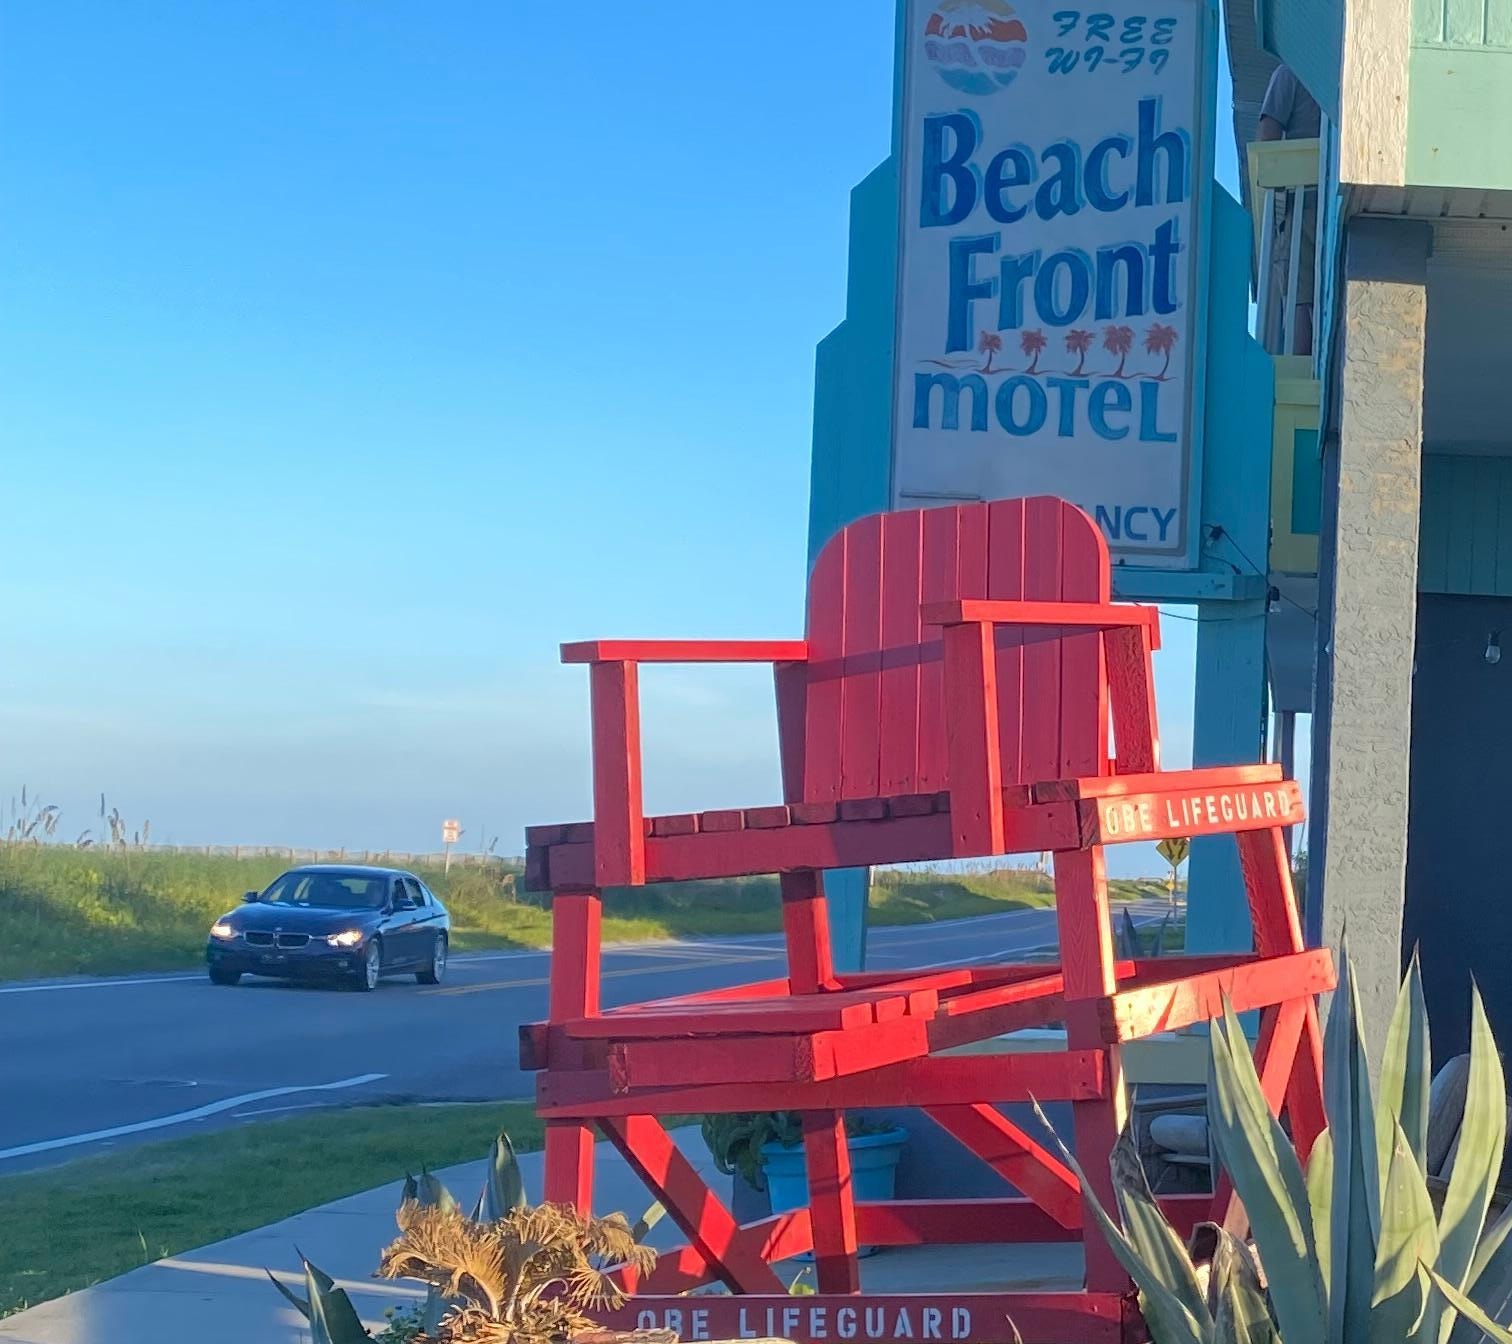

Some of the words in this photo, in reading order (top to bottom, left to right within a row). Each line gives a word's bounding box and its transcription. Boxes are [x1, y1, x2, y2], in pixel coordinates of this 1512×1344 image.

[1052, 10, 1178, 44] FREE
[1045, 46, 1170, 75] WI-FI
[919, 96, 1192, 229] Beach
[945, 217, 1183, 355] Front
[1105, 803, 1153, 835] OBE
[1166, 790, 1292, 828] LIFEGUARD
[739, 1307, 972, 1339] LIFEGUARD
